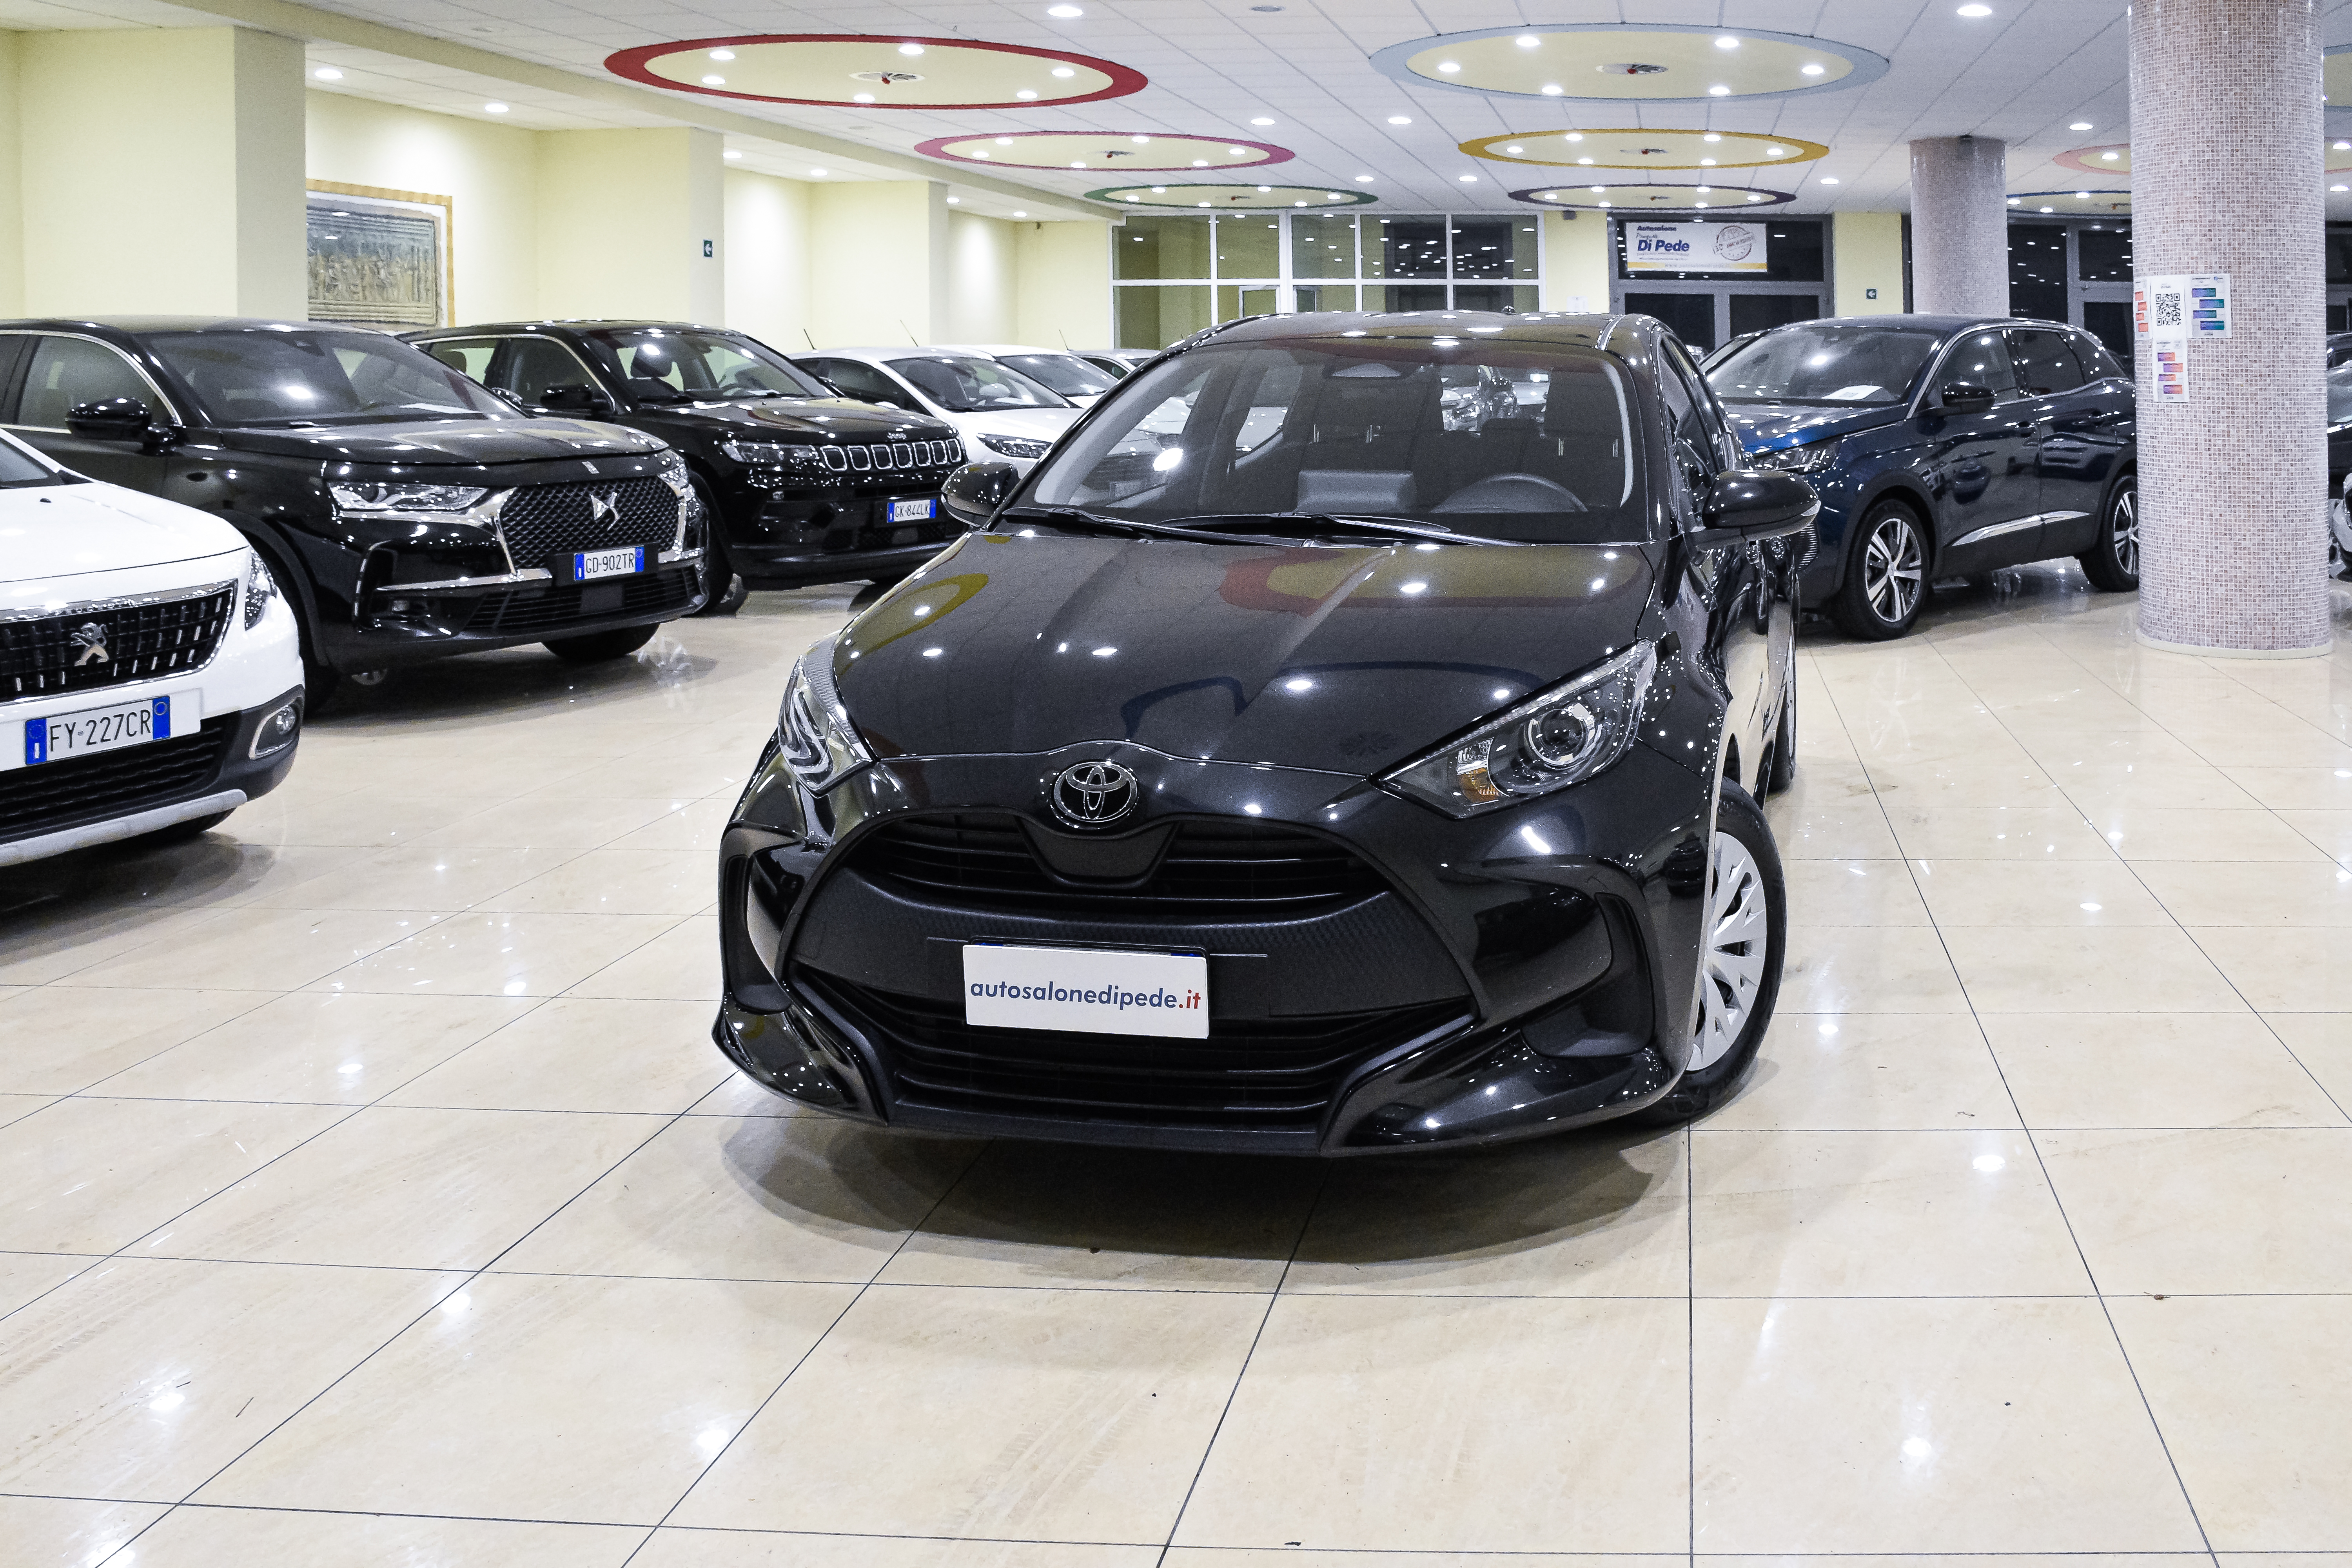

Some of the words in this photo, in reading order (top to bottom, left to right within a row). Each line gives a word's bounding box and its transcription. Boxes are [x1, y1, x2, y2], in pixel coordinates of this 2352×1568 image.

[1638, 240, 1652, 251] Di
[1655, 240, 1690, 252] Pede
[971, 981, 1201, 1010] autosalonedipede.it
